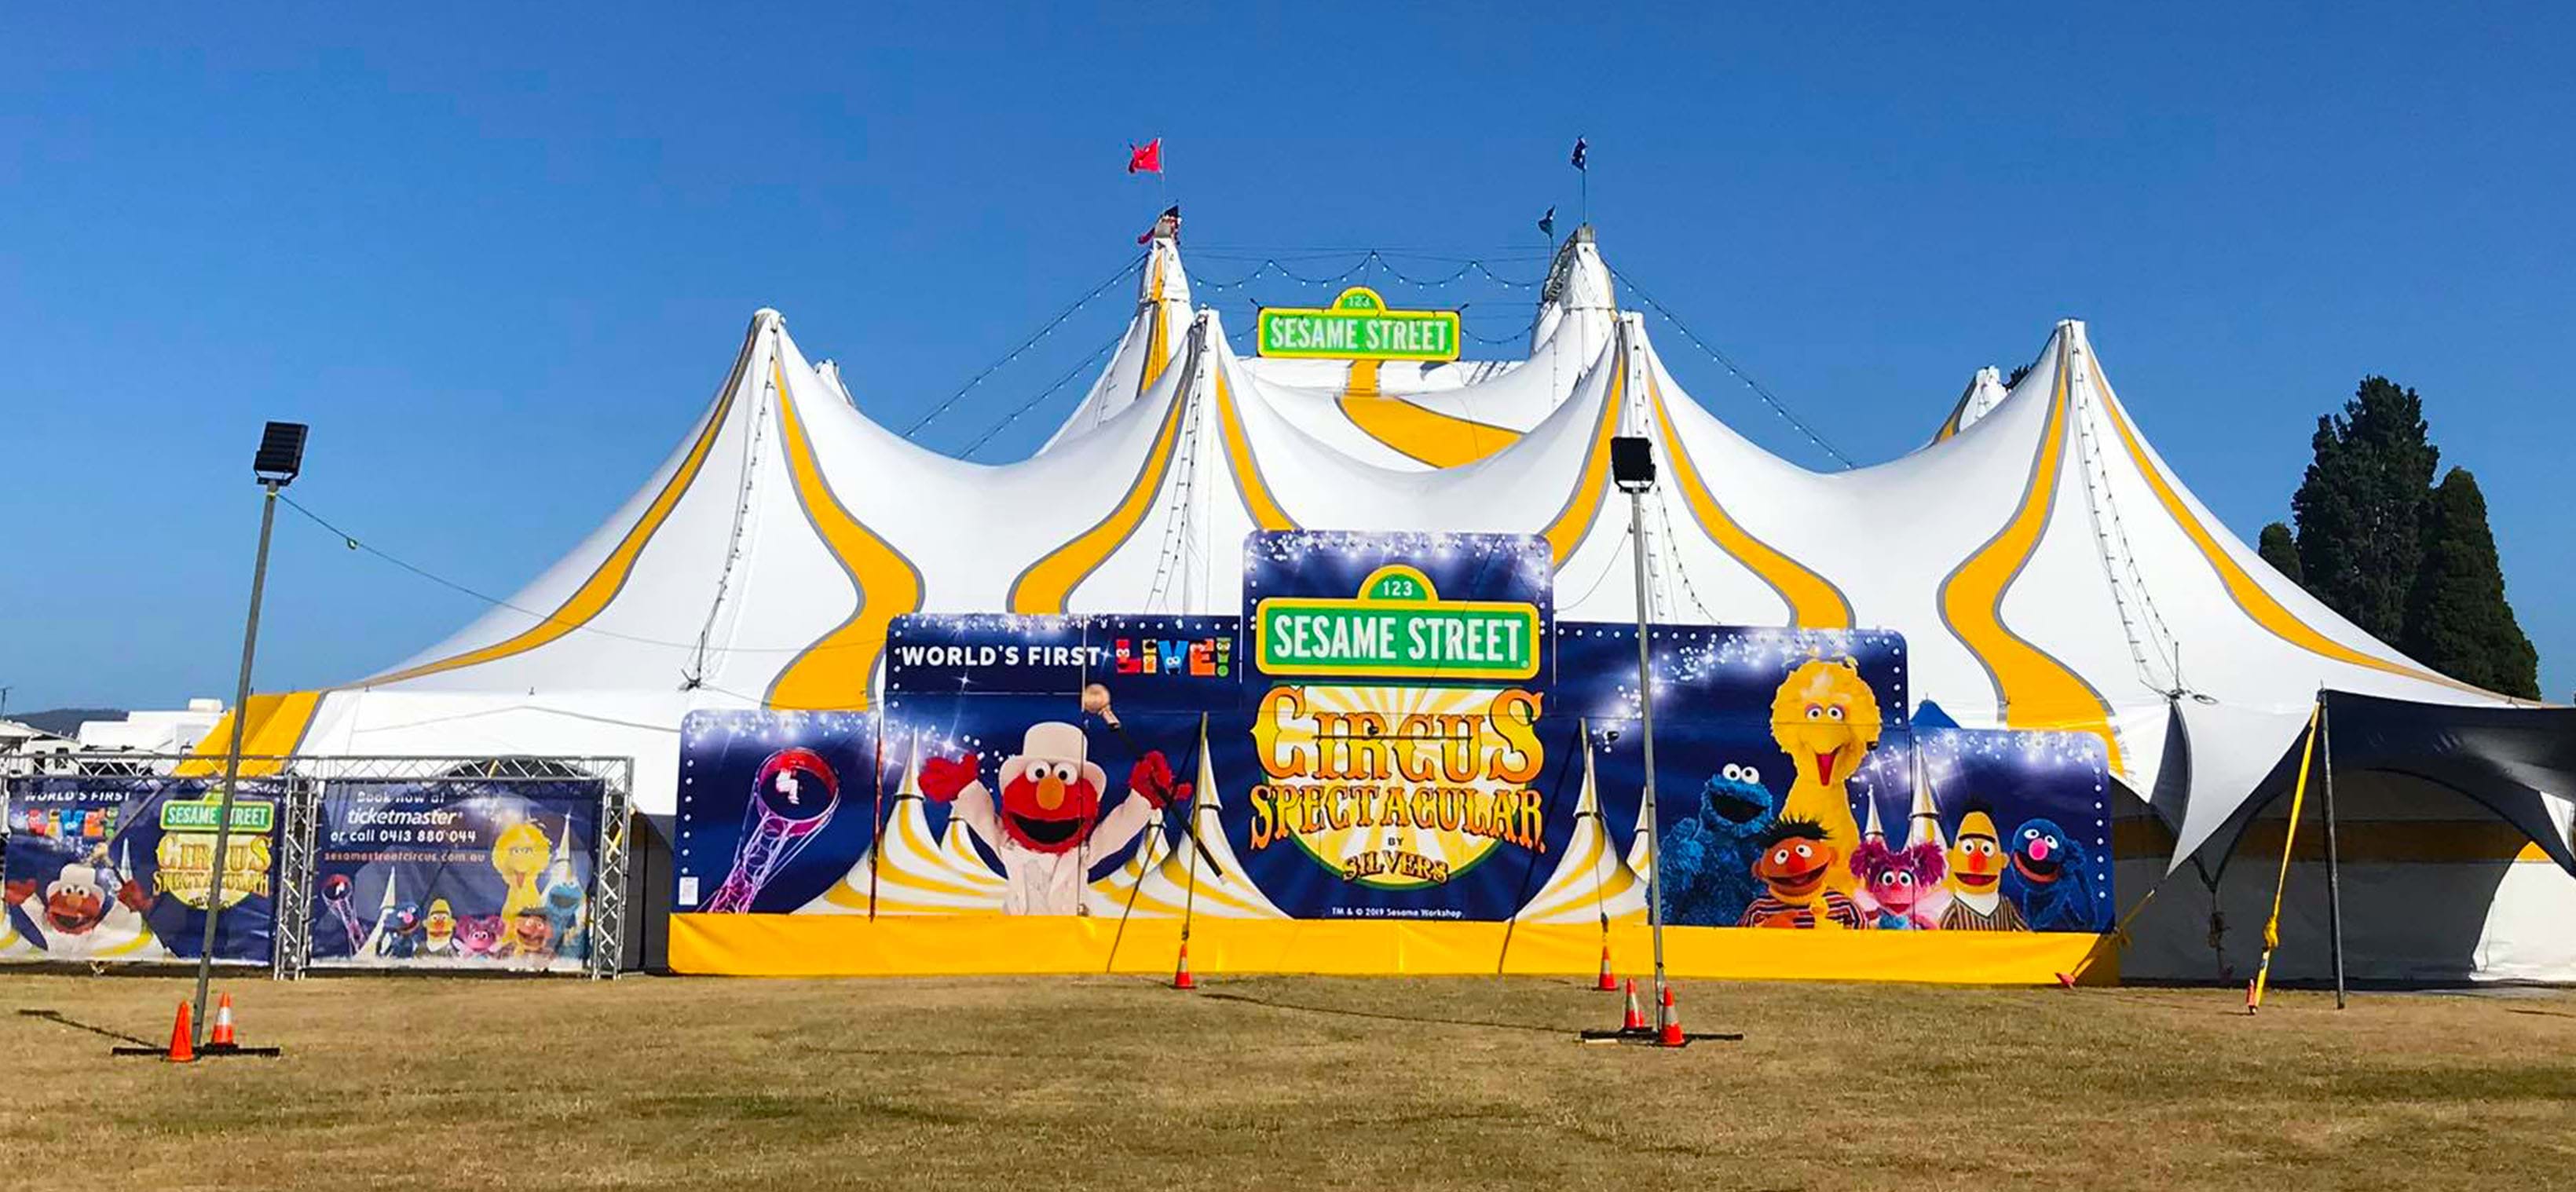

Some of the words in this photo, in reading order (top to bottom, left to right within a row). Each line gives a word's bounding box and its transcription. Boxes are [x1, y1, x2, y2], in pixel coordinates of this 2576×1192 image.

[1347, 295, 1370, 307] 123
[1270, 316, 1358, 349] SESAME
[1366, 320, 1448, 351] STREET
[1382, 580, 1413, 597] 123
[1274, 614, 1396, 660] SESAME
[1407, 617, 1523, 662] STREET
[902, 645, 1019, 667] WORLD'S
[1027, 646, 1101, 667] FIRST
[1249, 685, 1546, 785] CIRCUS
[357, 791, 392, 803] Book
[167, 806, 216, 825] SESAME
[229, 807, 268, 825] TREET
[347, 806, 457, 825] ticketmaster
[1250, 784, 1546, 854] SPECTACULAR
[330, 830, 346, 842] or
[349, 829, 375, 842] call
[379, 829, 412, 843] 0413
[417, 829, 445, 843] 880
[449, 830, 477, 843] 044
[1388, 837, 1404, 846] BY
[156, 832, 273, 872] CIRUS
[1342, 850, 1450, 885] SILVERS
[1332, 907, 1345, 916] TM
[1366, 908, 1385, 916] 2019
[1387, 908, 1418, 917] Sesame
[1421, 909, 1463, 918] Workshop
